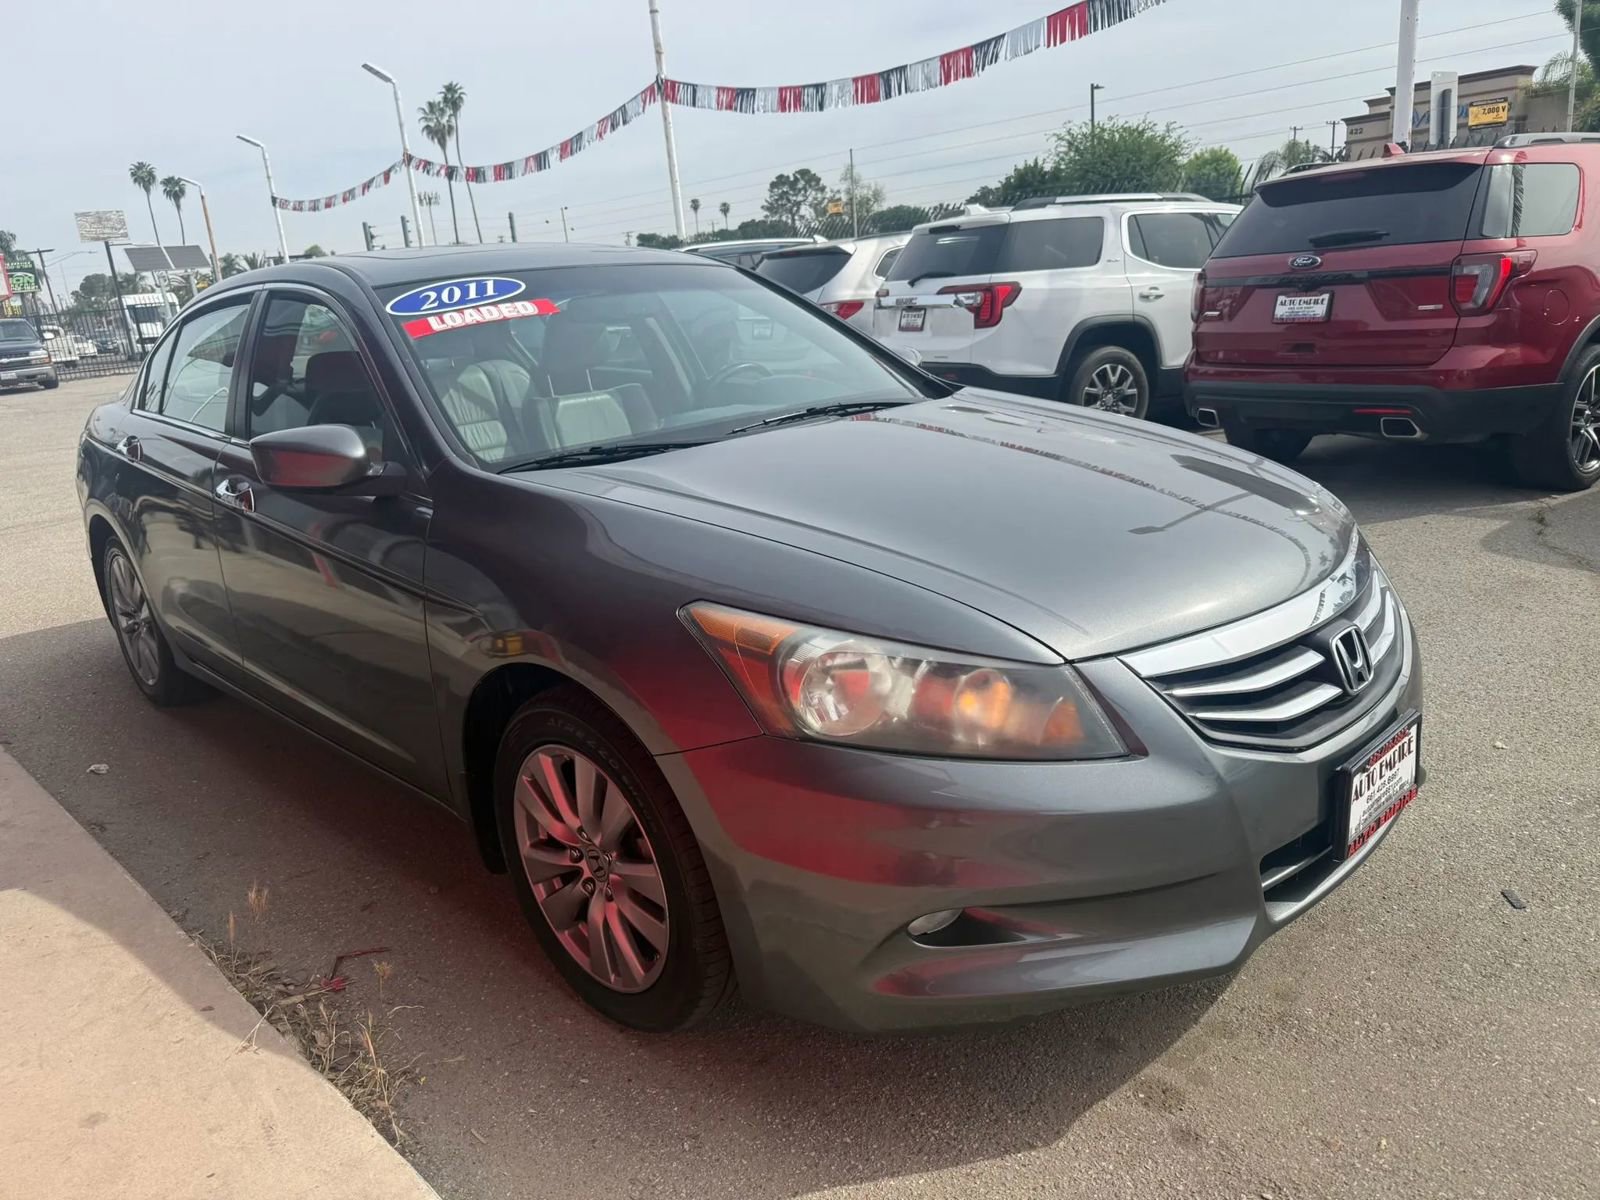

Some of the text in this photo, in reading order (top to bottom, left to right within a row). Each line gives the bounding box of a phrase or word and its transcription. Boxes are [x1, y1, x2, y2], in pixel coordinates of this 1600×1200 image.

[419, 280, 498, 310] 2011
[427, 301, 539, 331] LOADED
[1352, 767, 1377, 801] AUTO
[1379, 736, 1414, 780] EMPIRE
